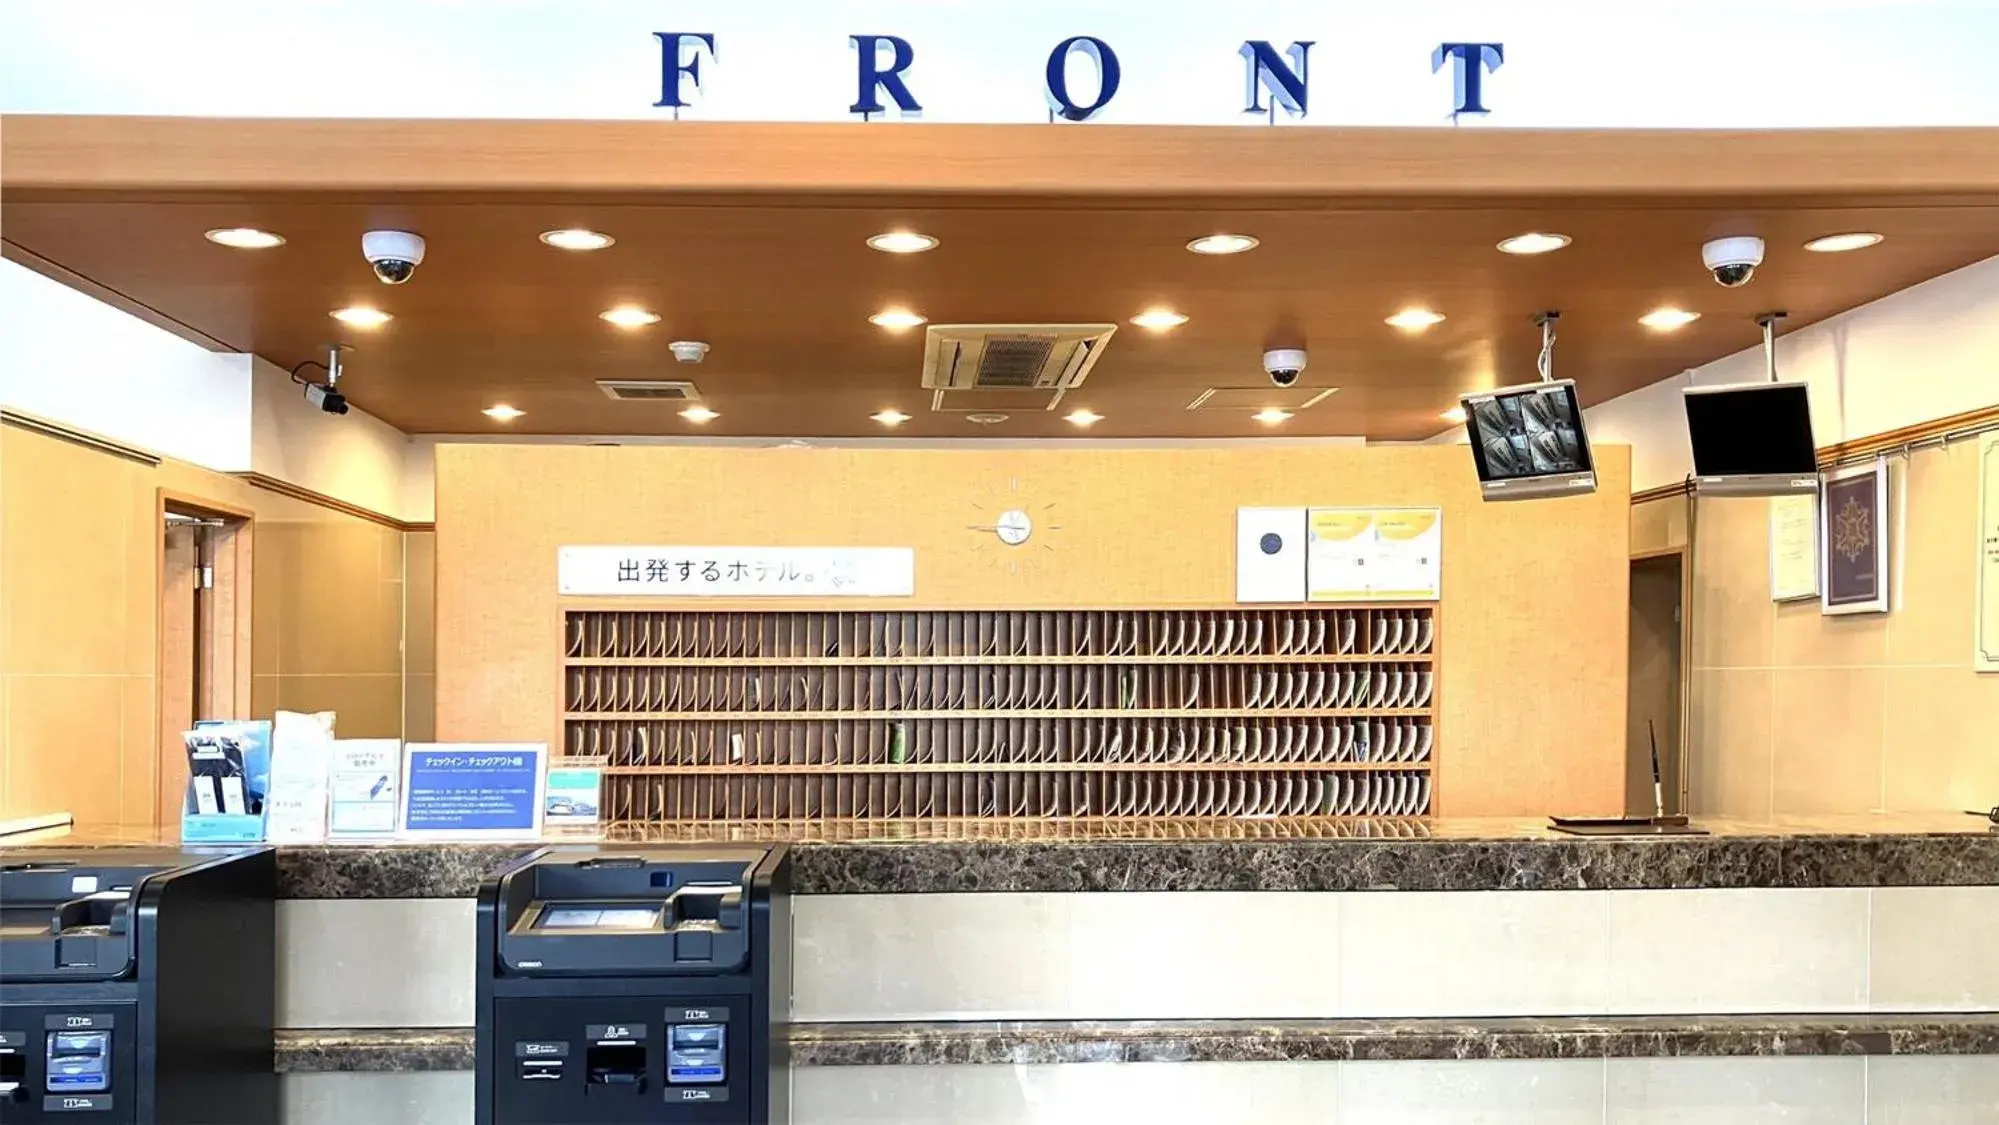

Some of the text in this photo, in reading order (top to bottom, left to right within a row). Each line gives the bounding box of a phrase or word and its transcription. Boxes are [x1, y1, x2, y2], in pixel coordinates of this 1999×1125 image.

[653, 32, 1505, 121] FRONT
[617, 558, 814, 583] 出発するホテル。
